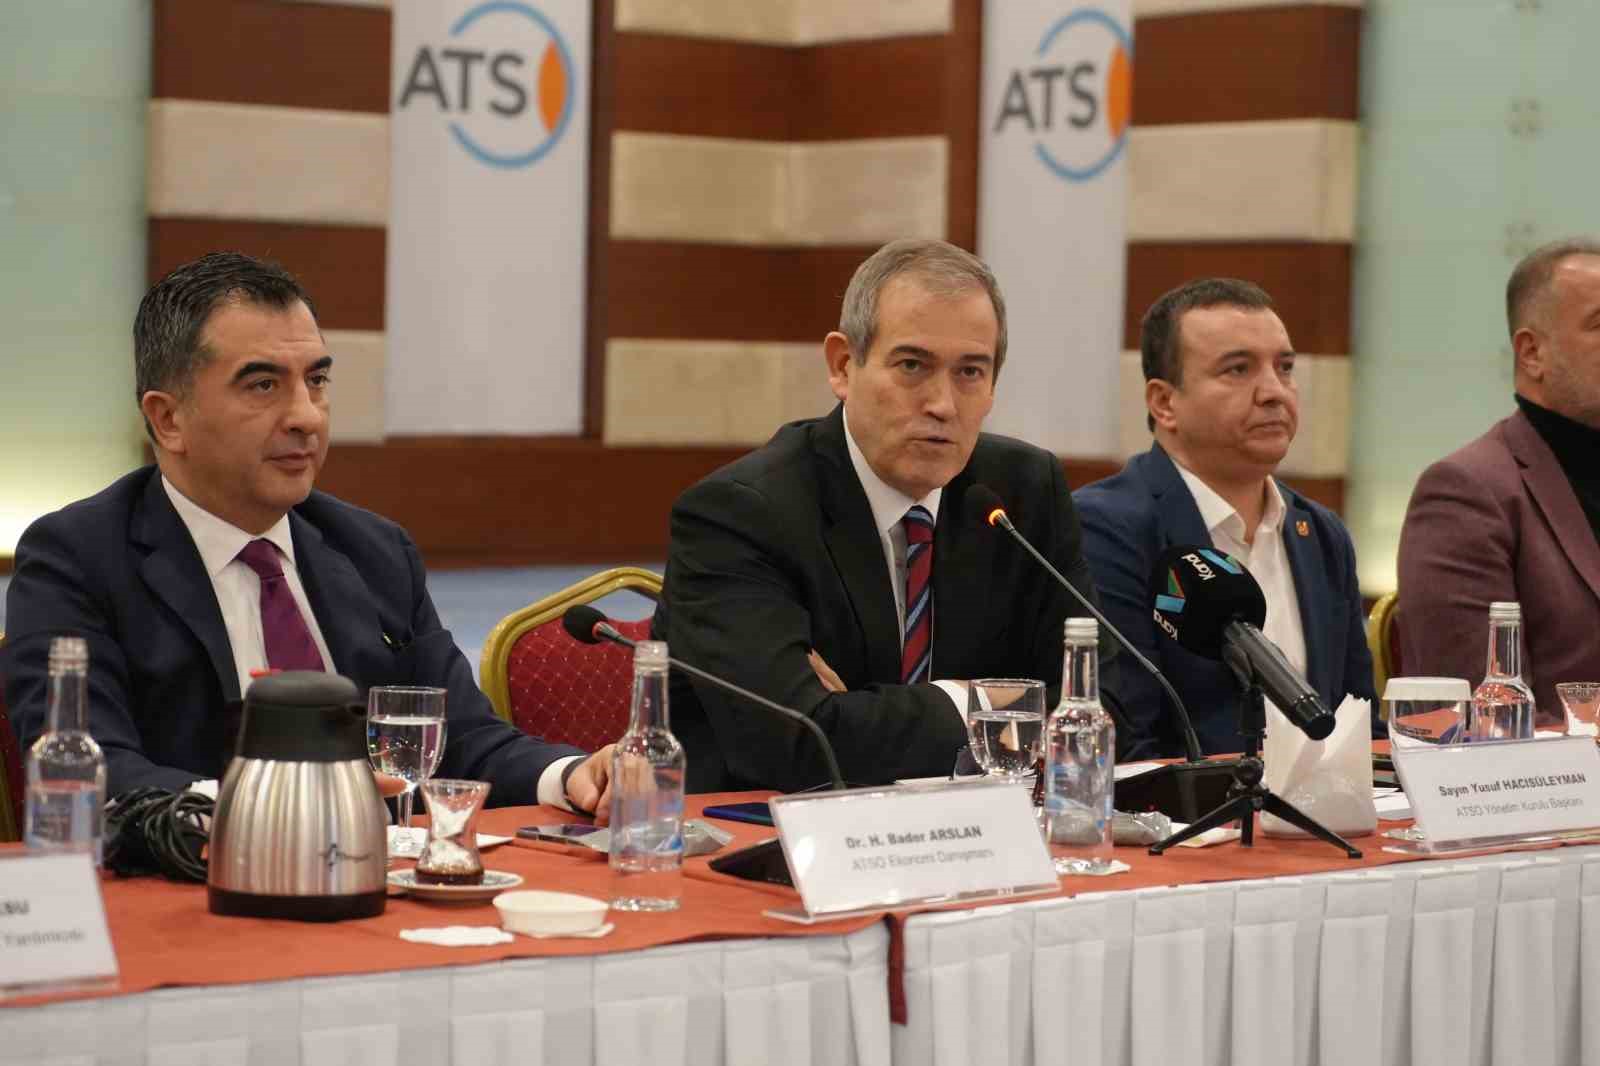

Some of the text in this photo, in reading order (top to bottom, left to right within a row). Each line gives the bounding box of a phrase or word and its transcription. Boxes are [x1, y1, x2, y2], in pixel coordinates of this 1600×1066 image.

[1471, 781, 1501, 794] Yusuf
[845, 825, 983, 850] Dr. H. Bader ARSLAN
